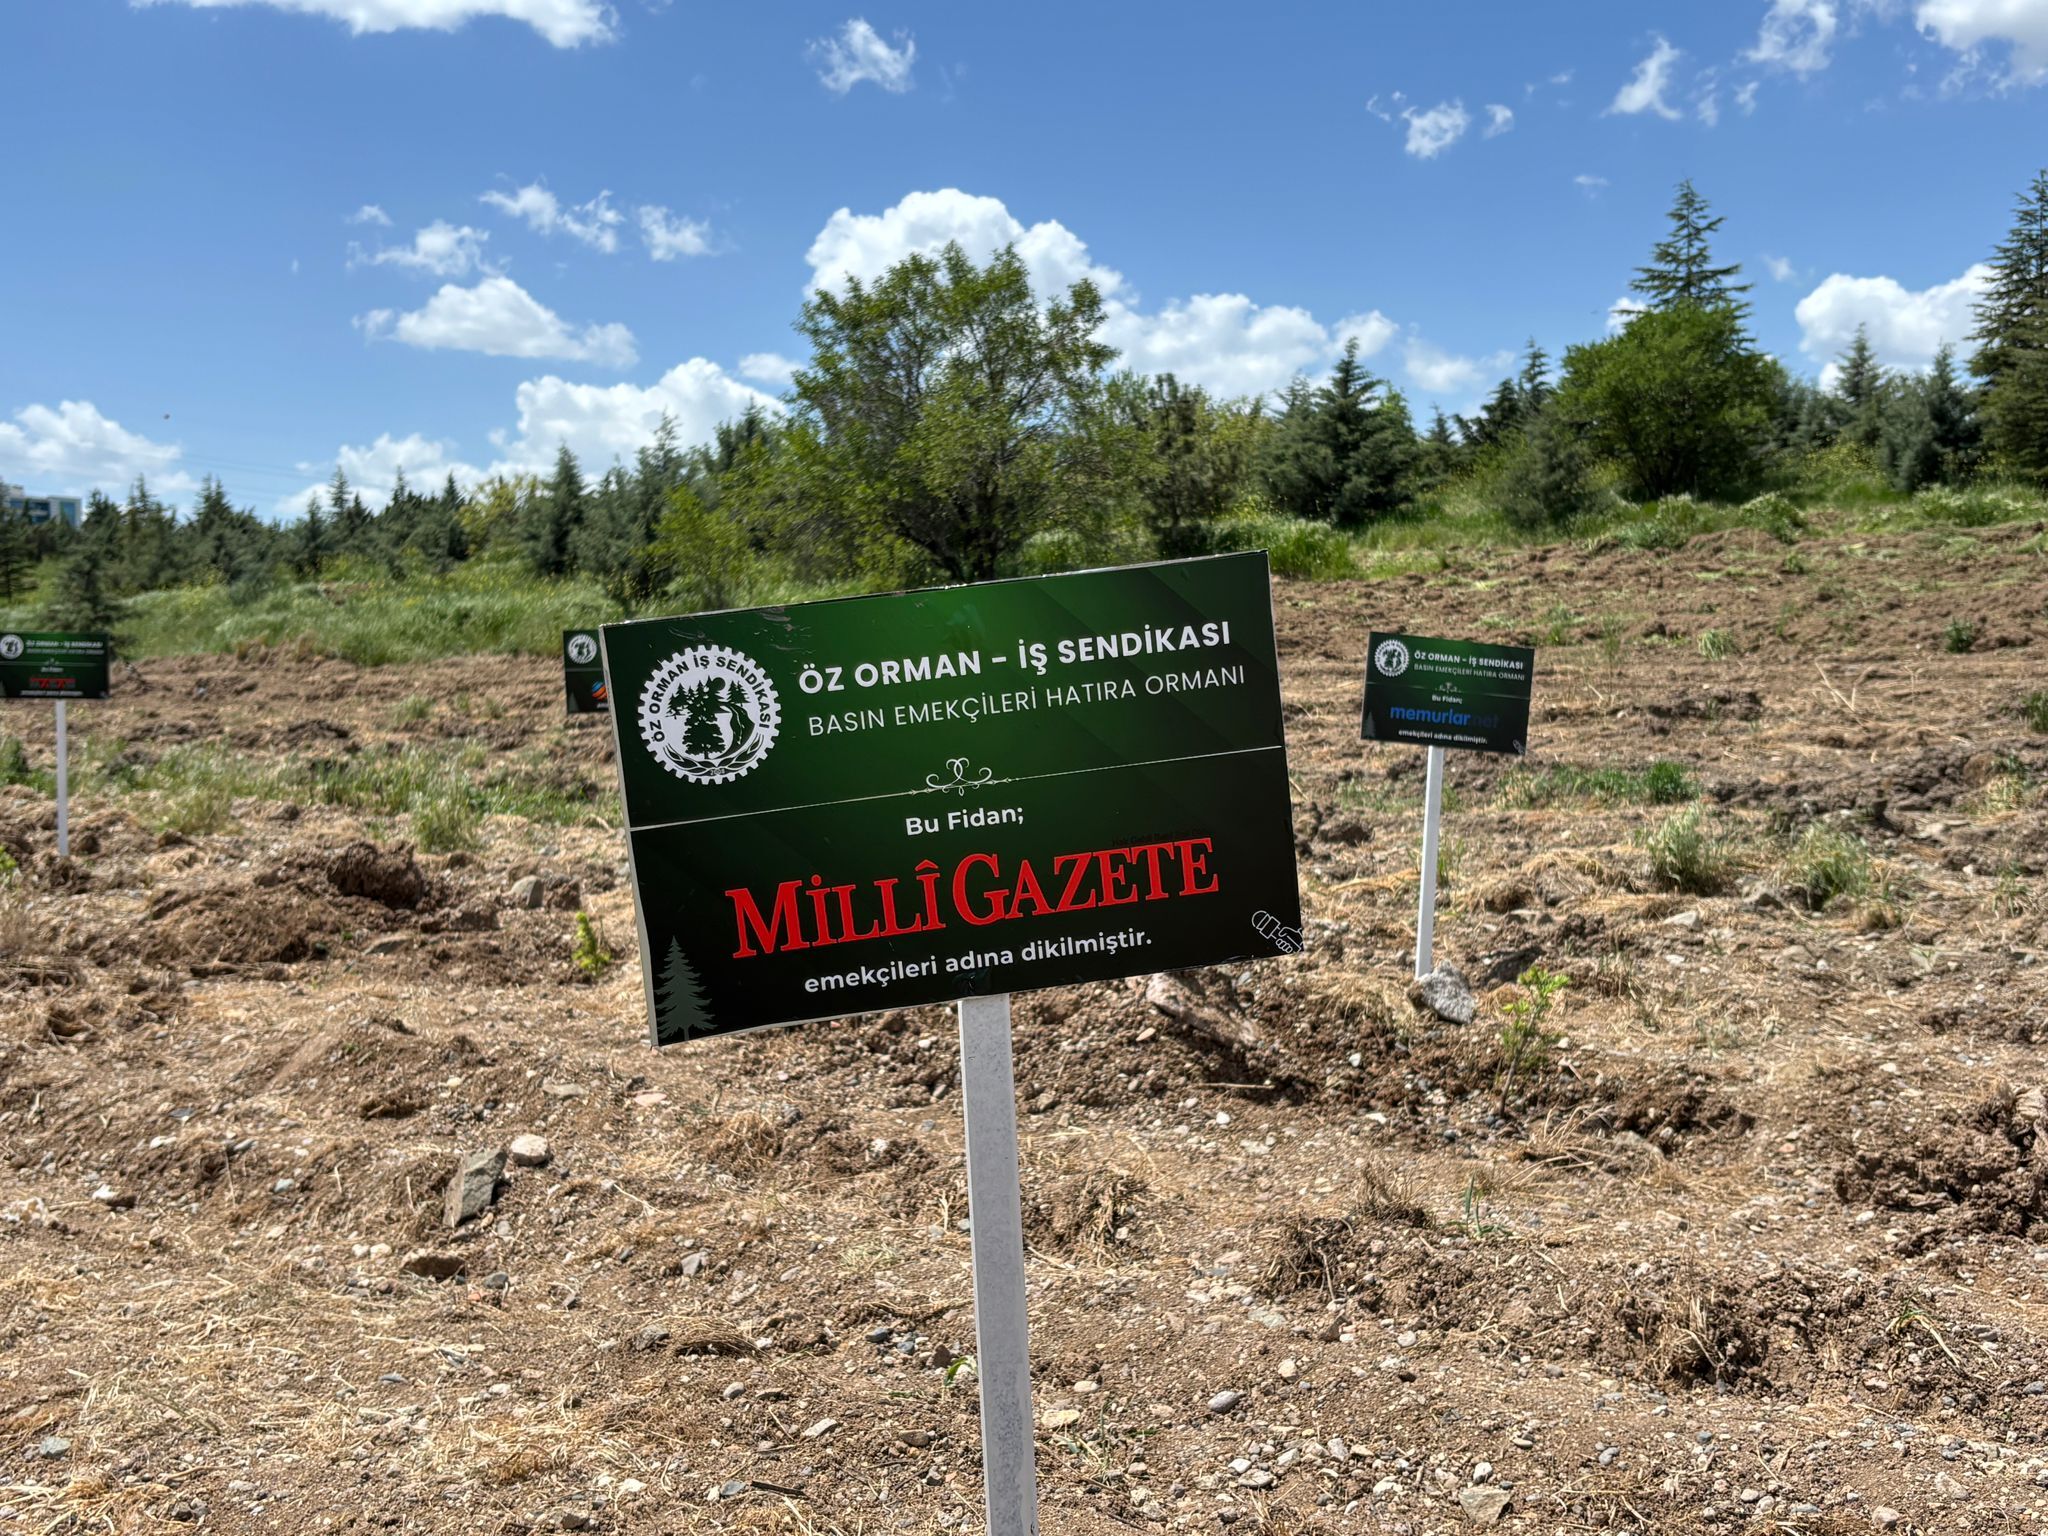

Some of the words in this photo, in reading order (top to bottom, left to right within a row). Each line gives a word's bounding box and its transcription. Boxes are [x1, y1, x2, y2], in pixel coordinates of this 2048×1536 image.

[693, 655, 711, 669] İŞ
[799, 663, 845, 694] ÖZ
[854, 650, 981, 688] ORMAN
[1018, 639, 1048, 676] İŞ
[1057, 621, 1231, 664] SENDİKASI
[1414, 650, 1426, 660] ÖZ
[1428, 653, 1460, 664] ORMAN
[1469, 656, 1477, 667] İŞ
[1479, 657, 1524, 670] SENDİKASI
[1414, 663, 1434, 672] BASIN
[649, 661, 690, 714] ORMAN
[715, 656, 771, 729] SENDİKASI
[809, 708, 885, 737] BASIN
[894, 686, 1038, 726] EMEKÇİLERİ
[1046, 679, 1137, 708] HATIRA
[1145, 665, 1245, 695] ORMANI
[1431, 694, 1441, 702] Bu
[650, 719, 665, 742] ÖZ
[905, 817, 940, 836] Bu
[947, 807, 1024, 831] Fidan;
[804, 955, 938, 994] emekçileri
[945, 950, 1014, 974] adına
[1021, 928, 1153, 962] dikilmiştir.
